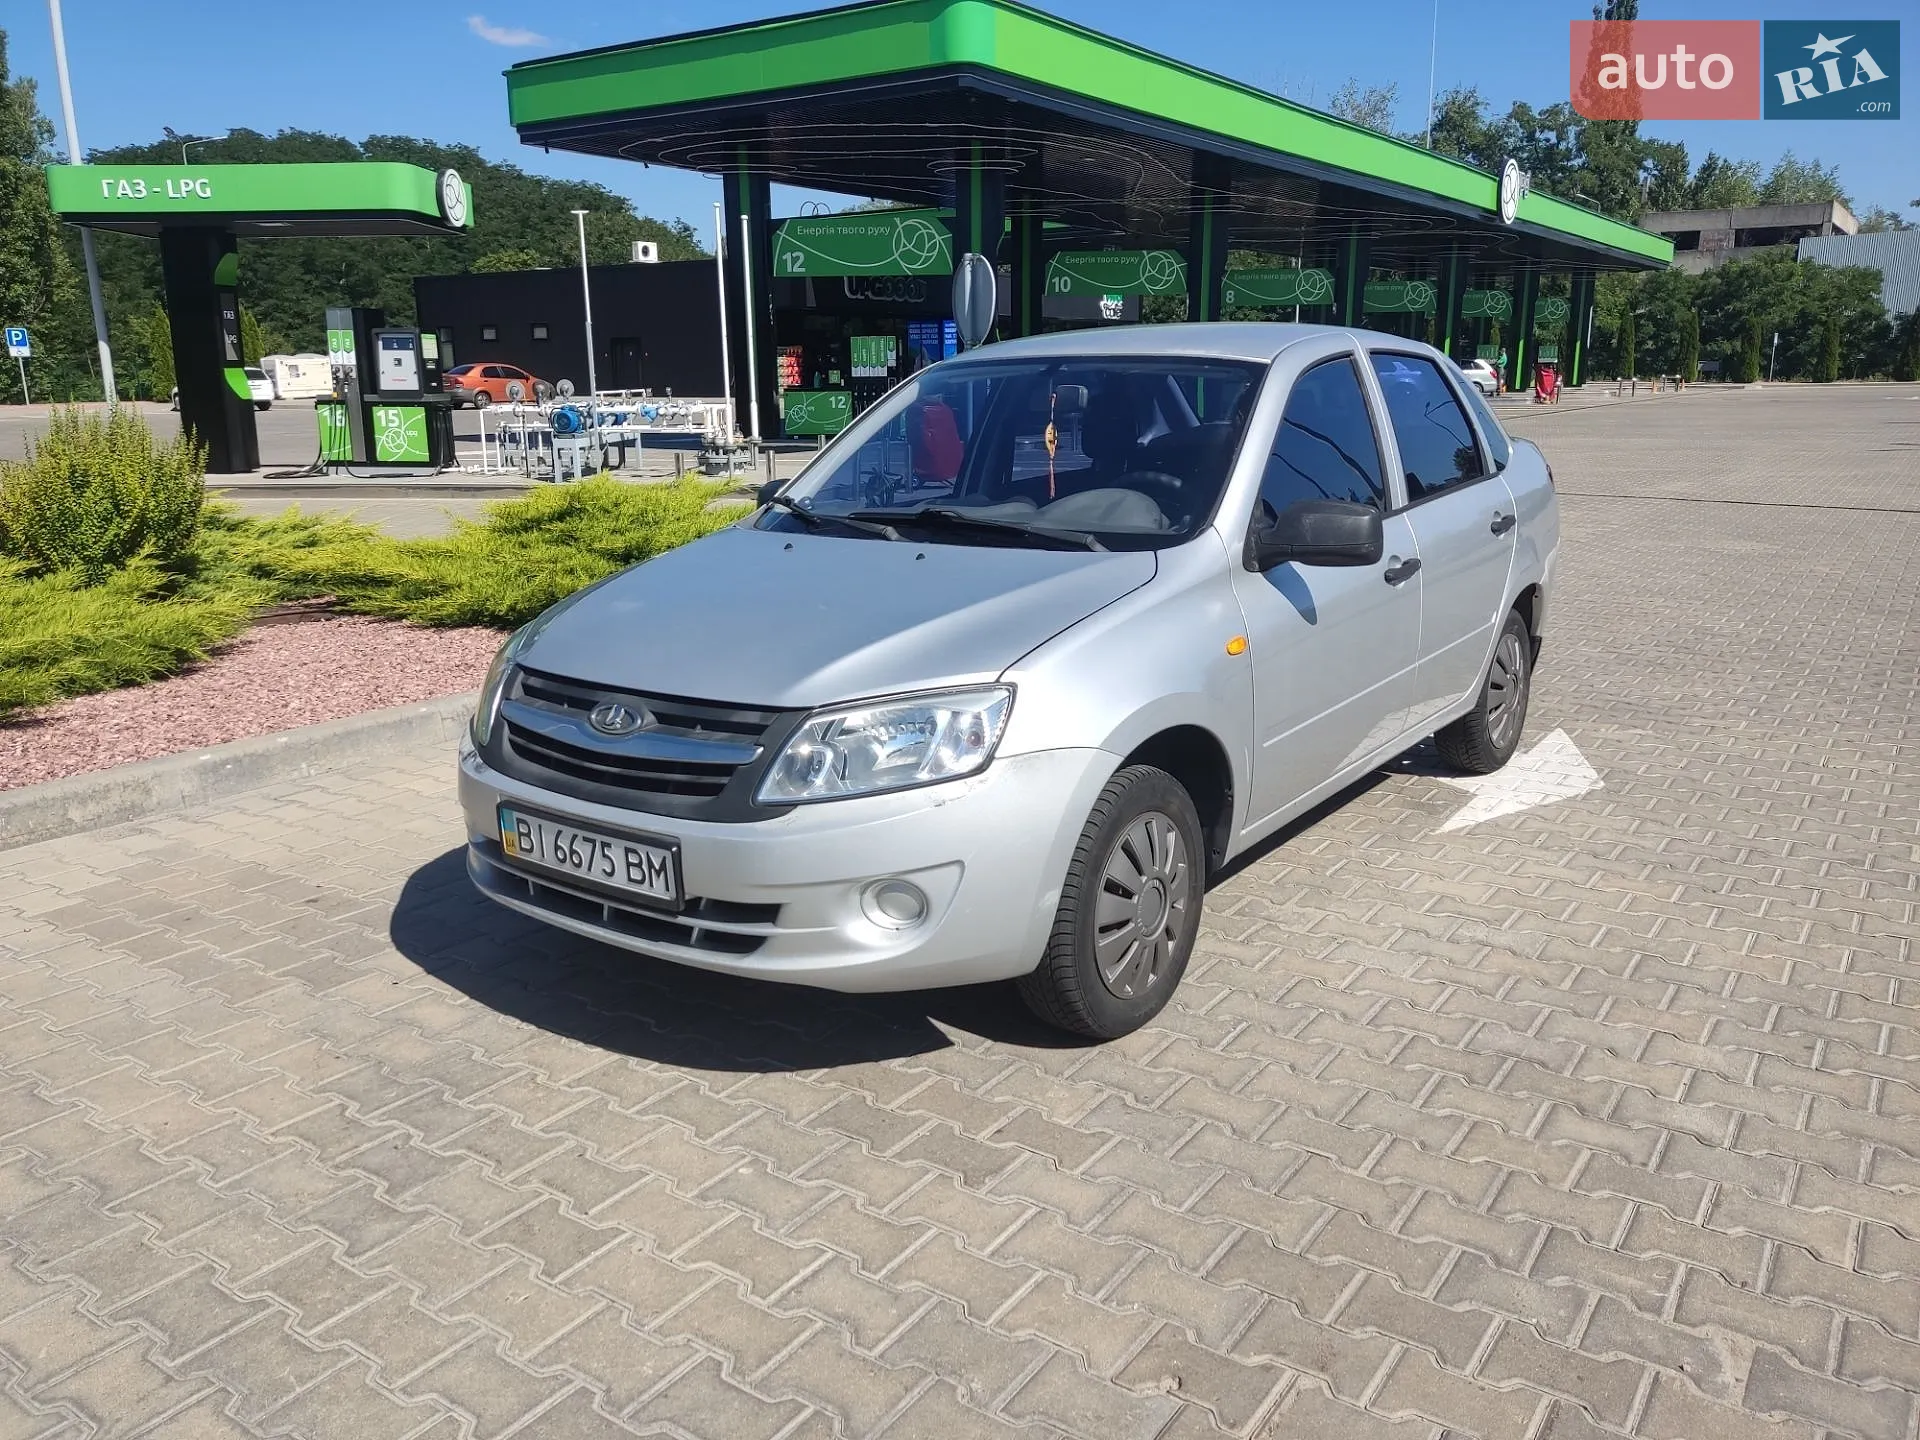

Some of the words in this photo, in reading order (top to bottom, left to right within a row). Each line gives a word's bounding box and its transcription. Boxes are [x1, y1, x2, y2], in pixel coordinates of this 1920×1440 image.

[101, 179, 148, 199] ГАЗ
[166, 179, 212, 199] LPG
[797, 225, 835, 237] Енергія
[838, 227, 865, 235] твого
[867, 226, 891, 236] руху
[782, 251, 806, 273] 12
[1065, 255, 1096, 265] Енергія
[1096, 256, 1120, 264] твого
[1120, 256, 1140, 265] руху
[1052, 276, 1071, 293] 10
[1226, 290, 1235, 304] 8
[11, 330, 23, 346] P
[828, 396, 847, 409] 12
[376, 409, 400, 428] 15
[506, 838, 516, 849] UA
[516, 817, 546, 859] BI
[554, 829, 616, 878] 6675
[624, 845, 670, 893] BM
